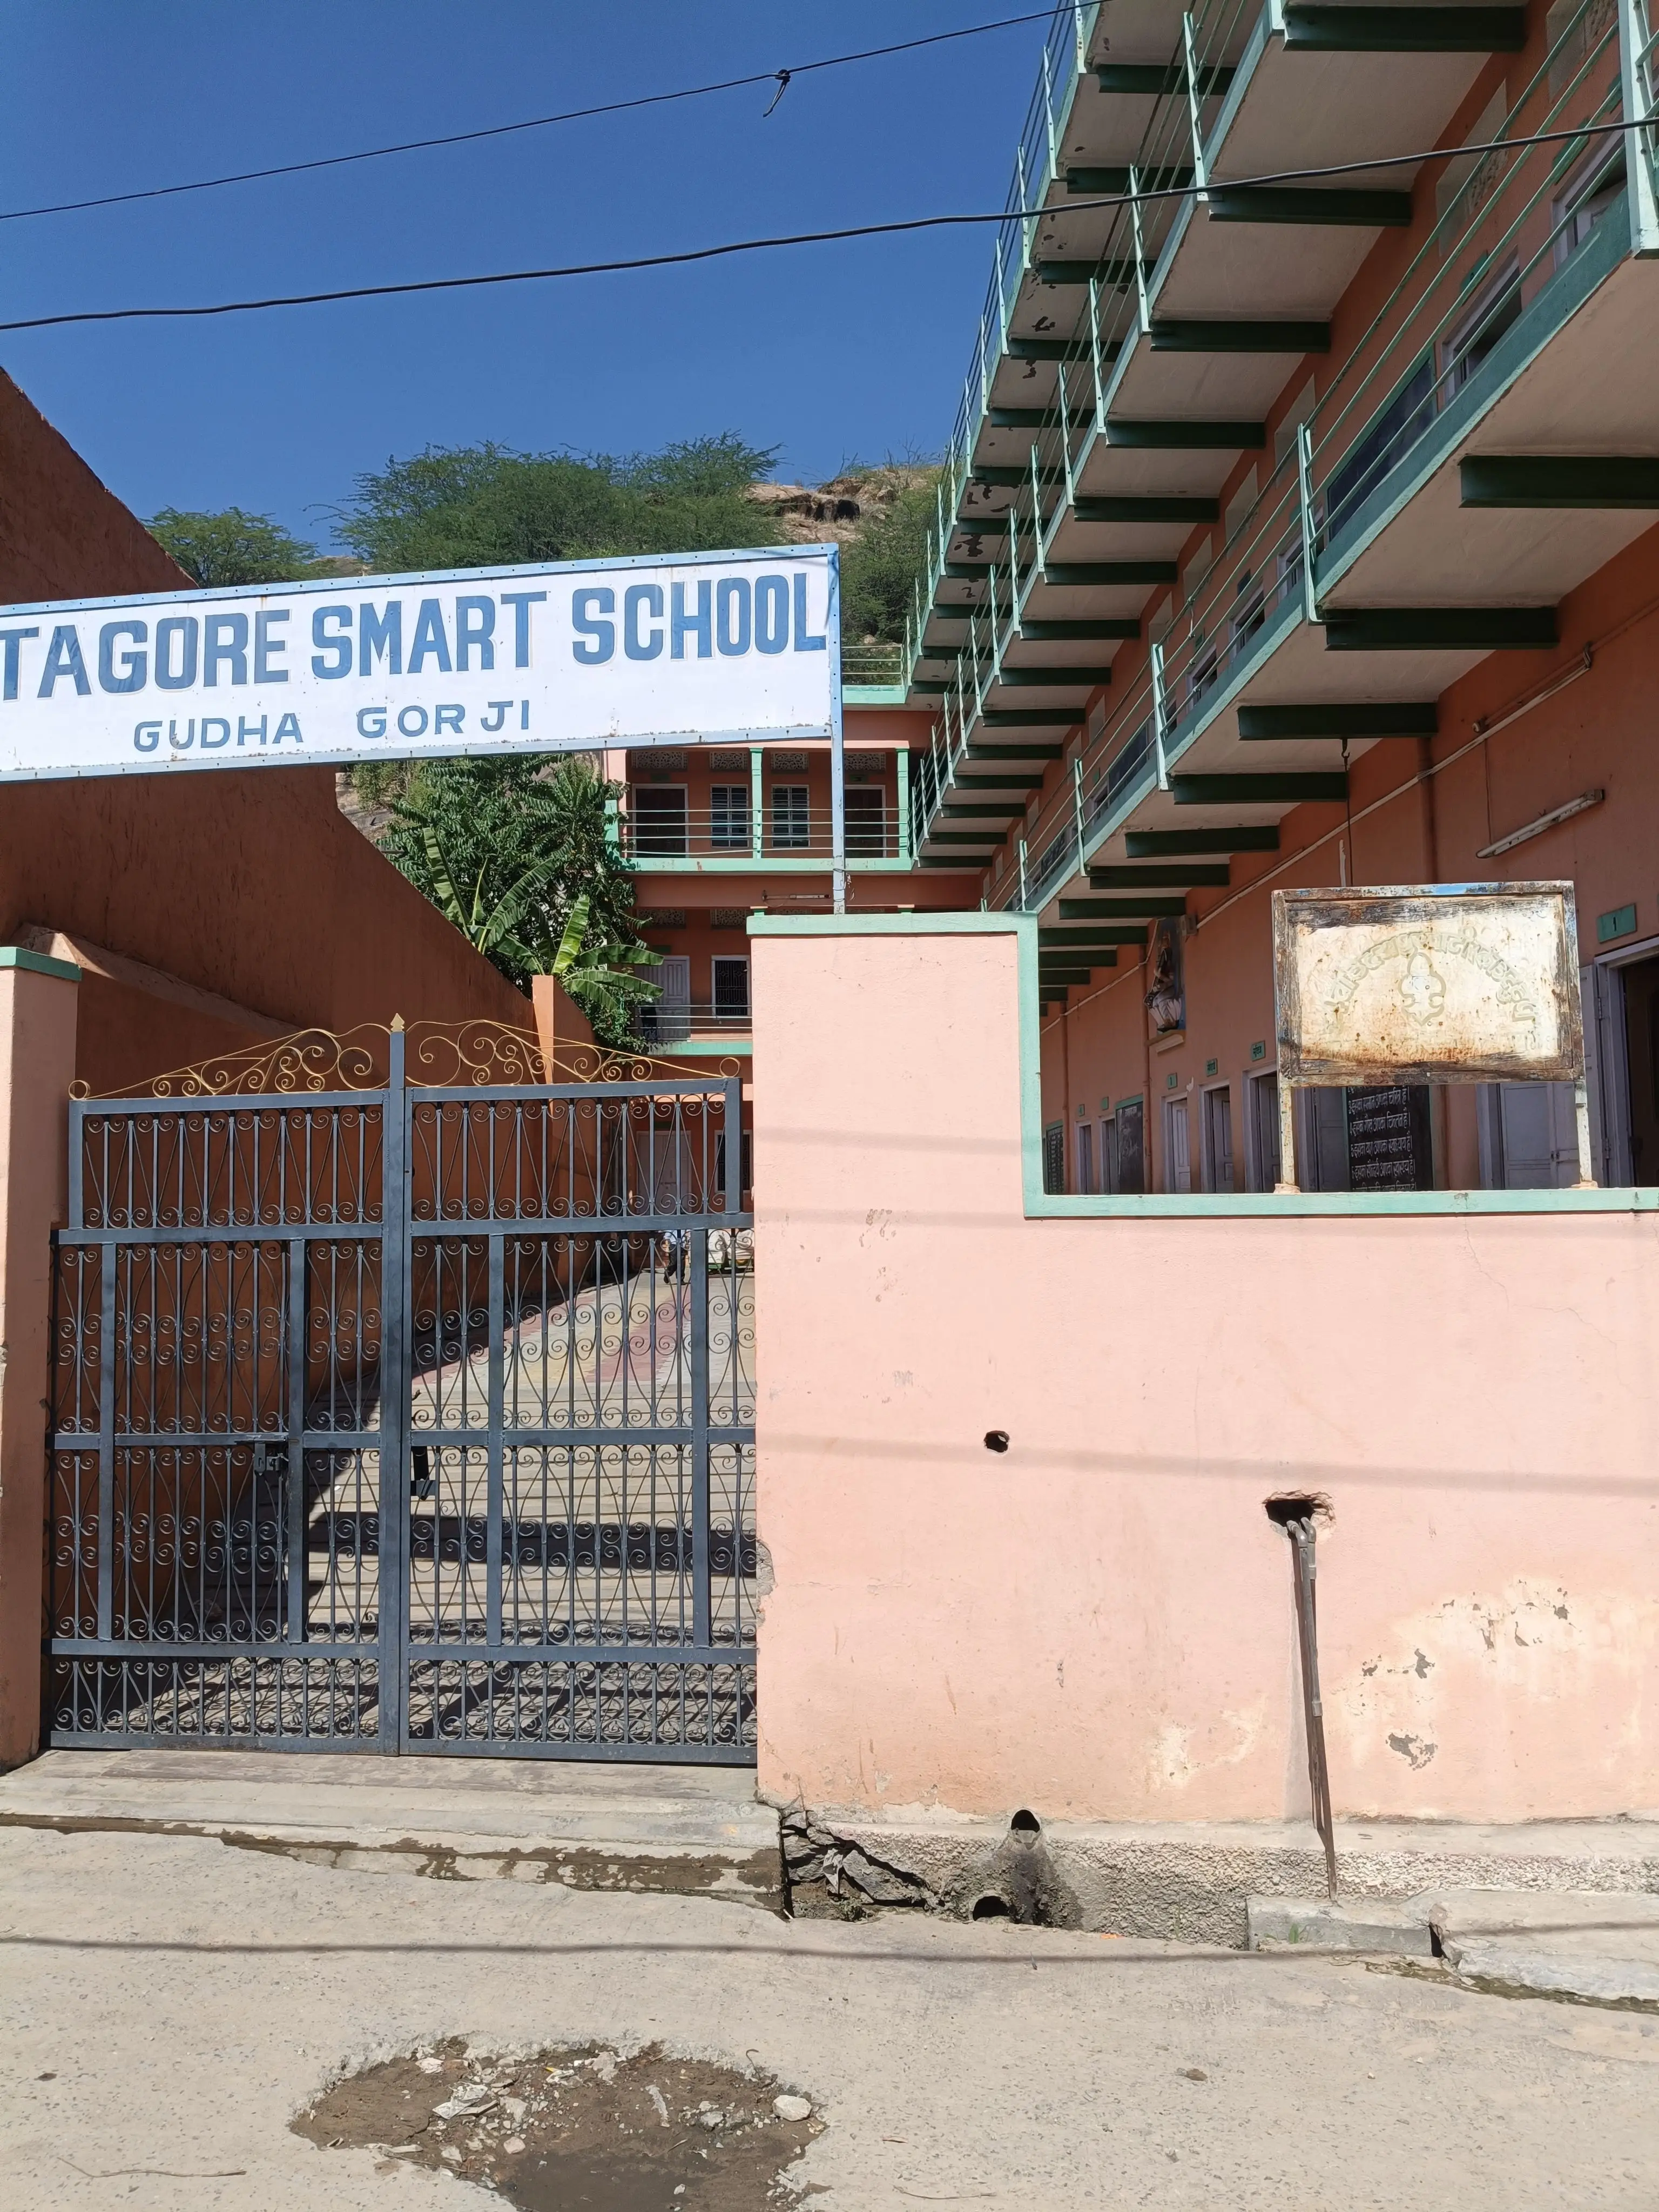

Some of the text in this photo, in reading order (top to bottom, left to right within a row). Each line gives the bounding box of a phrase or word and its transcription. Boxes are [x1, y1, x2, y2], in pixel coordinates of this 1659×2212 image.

[0, 573, 826, 700] TAGORE SMART SCHOOL
[134, 713, 303, 751] GUDHA
